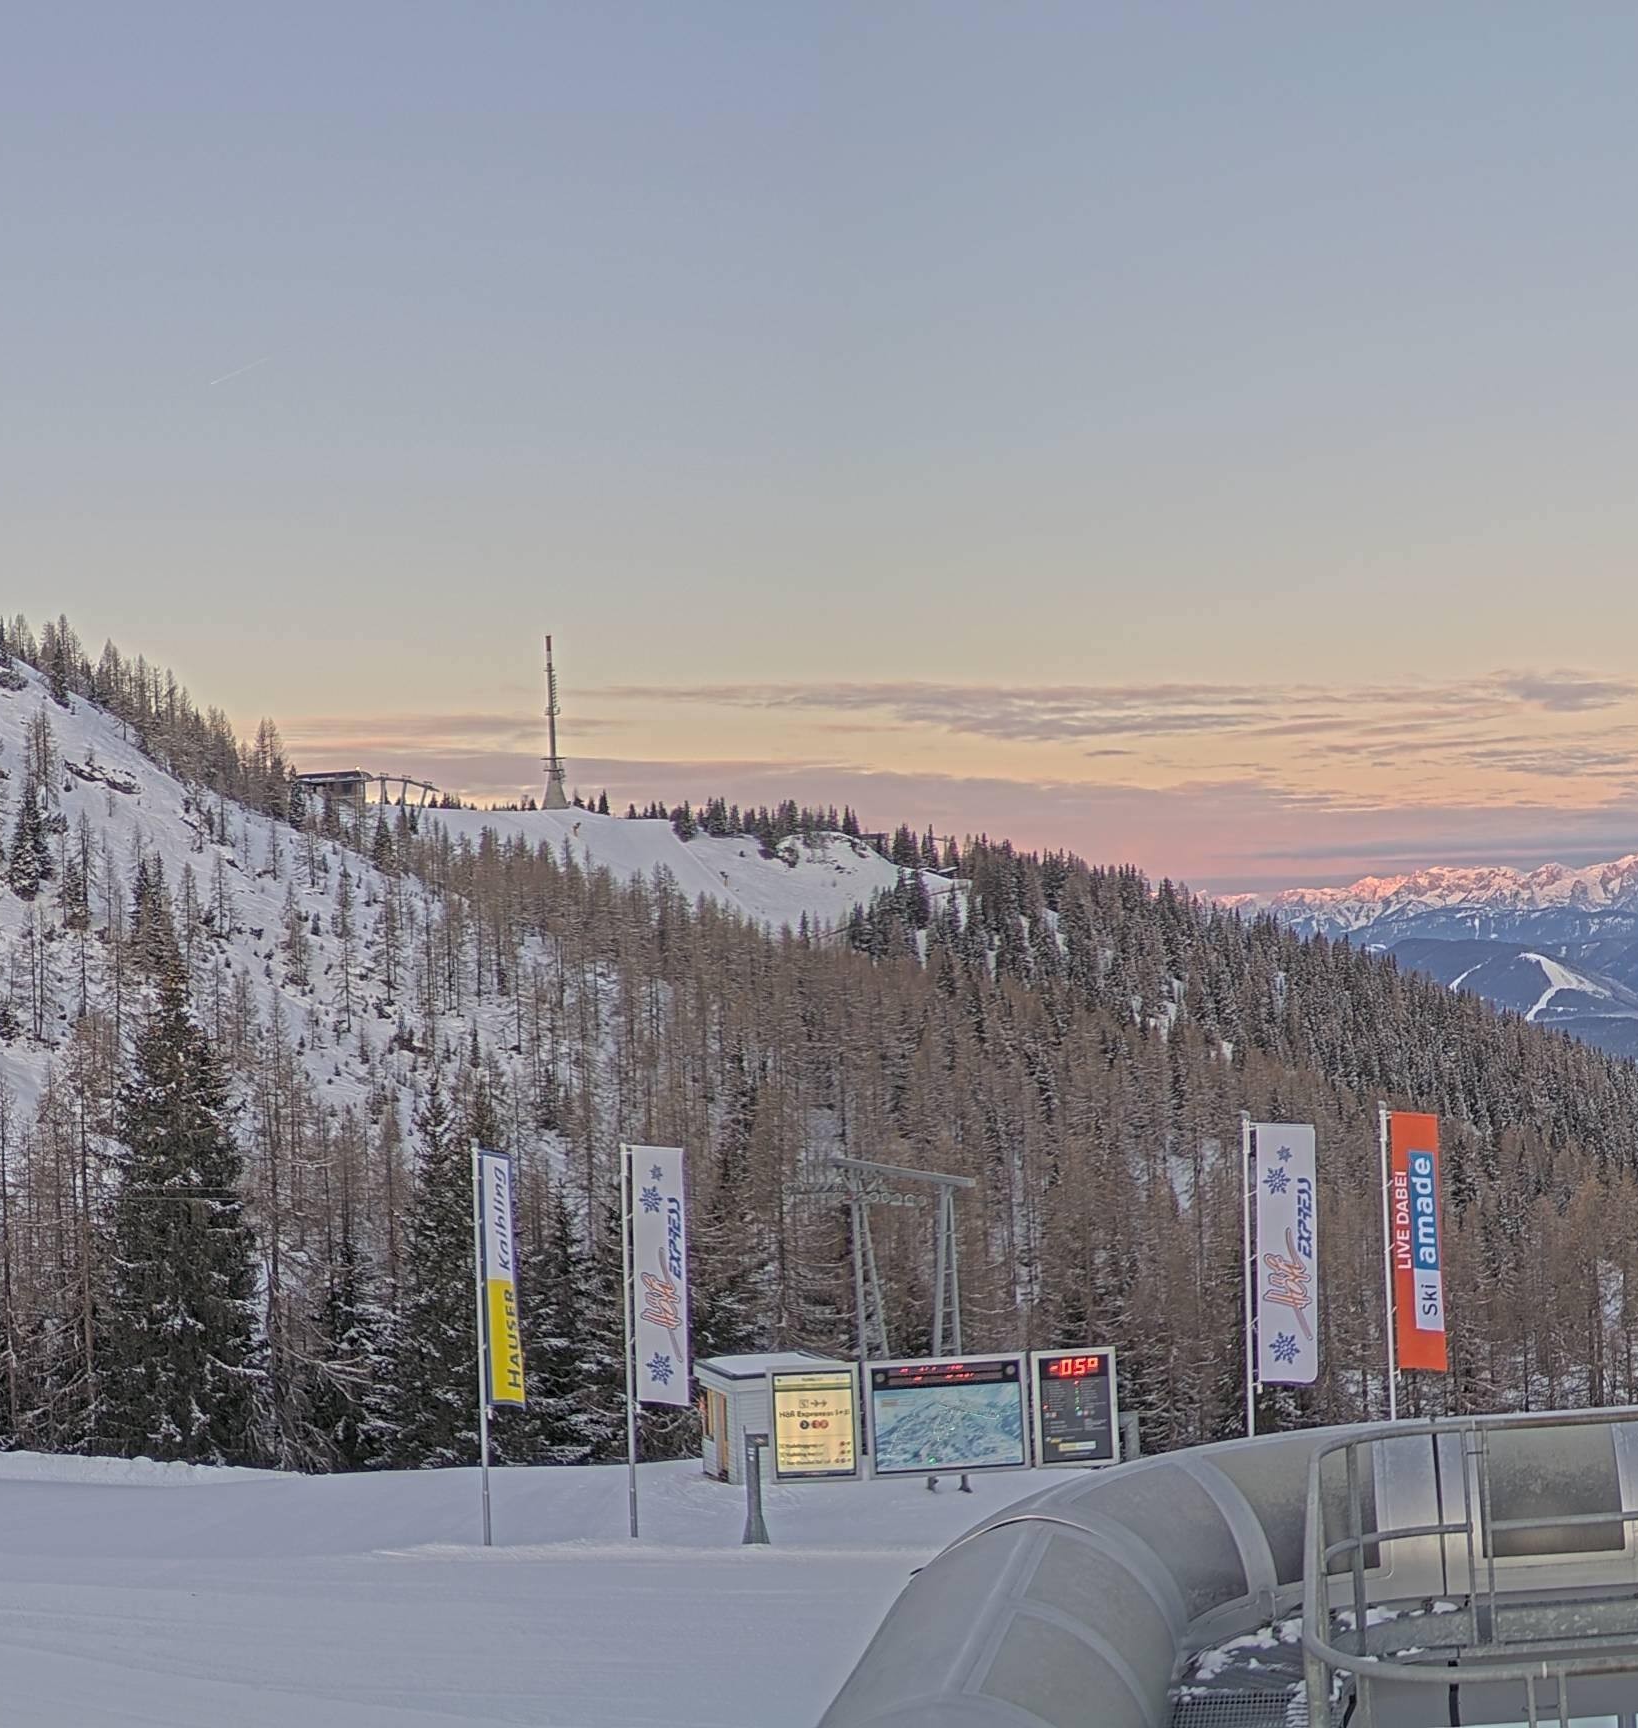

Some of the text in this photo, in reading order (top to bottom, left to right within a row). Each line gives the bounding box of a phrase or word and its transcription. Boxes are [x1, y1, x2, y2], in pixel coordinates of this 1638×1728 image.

[667, 1197, 683, 1281] EXPRESS
[1297, 1177, 1313, 1260] EXPRESS
[1395, 1171, 1412, 1269] LIVE DABEI
[504, 1288, 522, 1389] HAUSER
[1422, 1283, 1439, 1316] Ski
